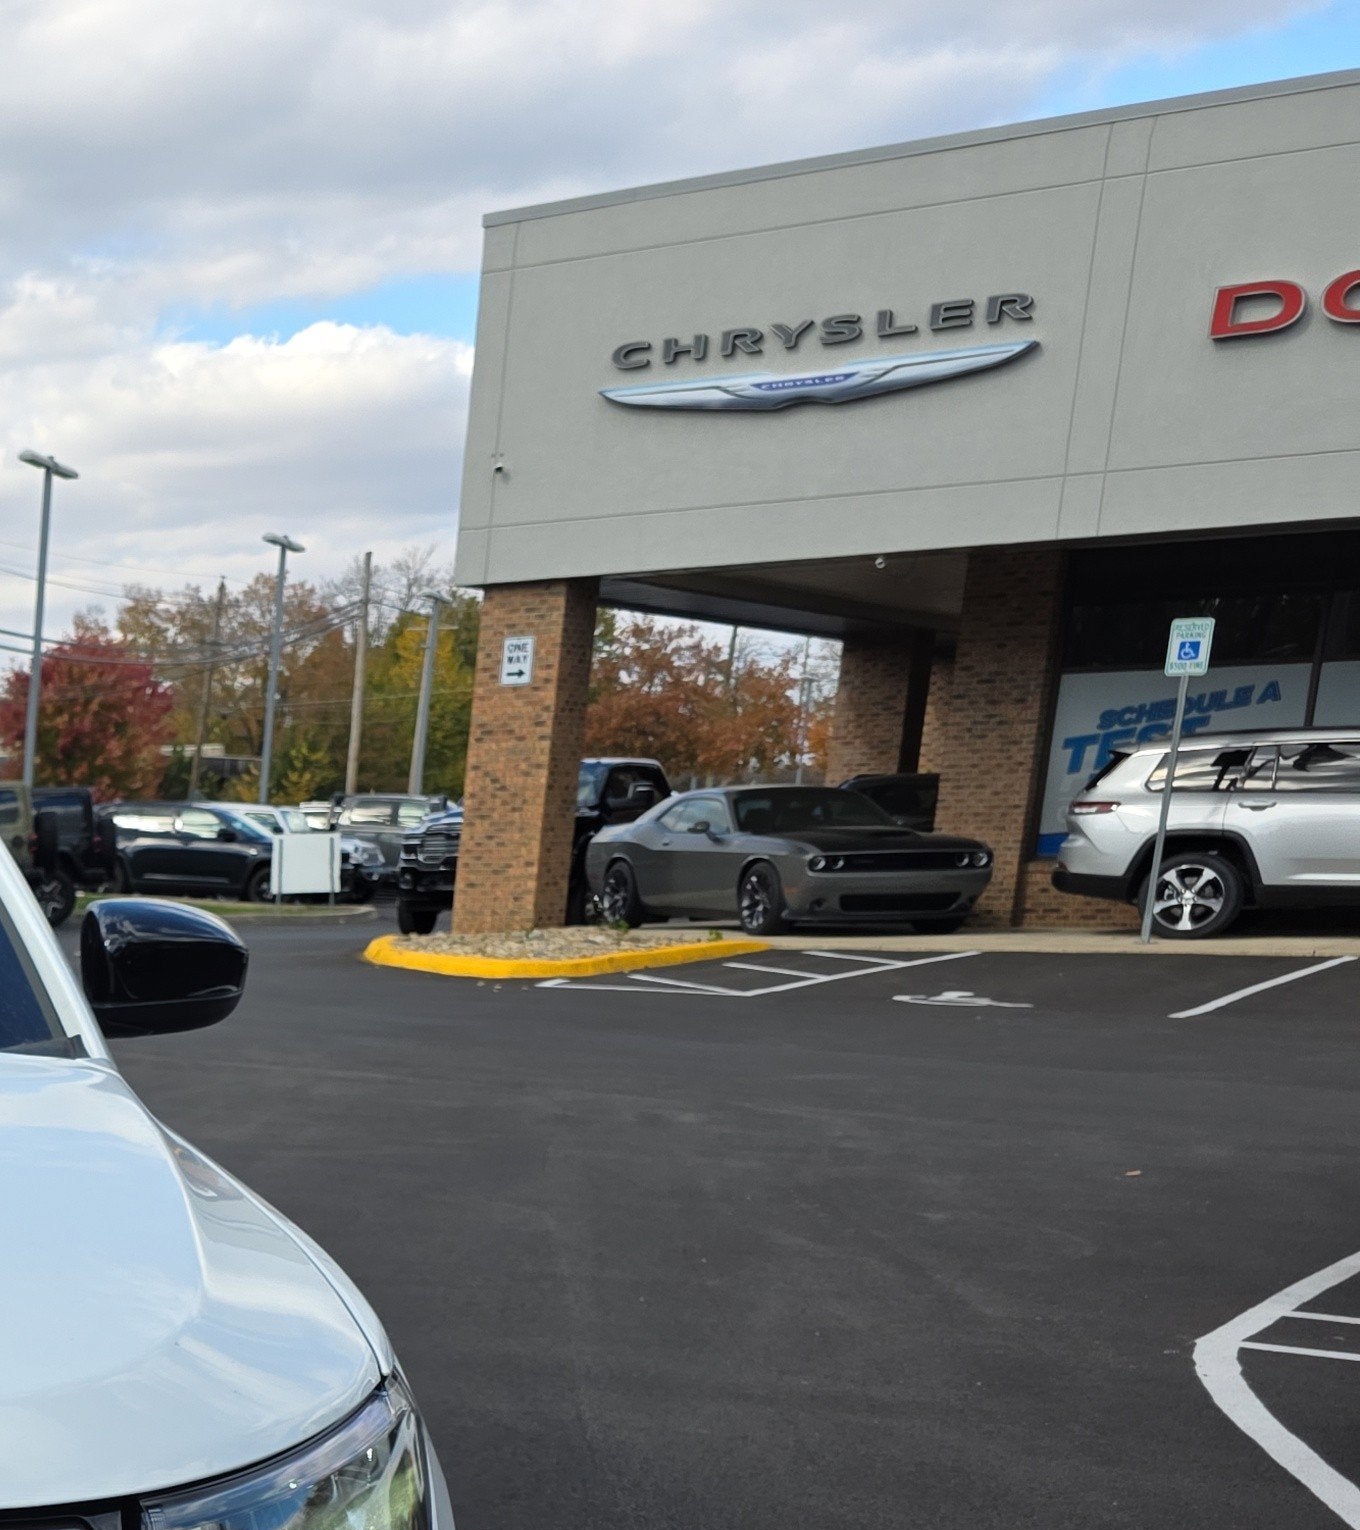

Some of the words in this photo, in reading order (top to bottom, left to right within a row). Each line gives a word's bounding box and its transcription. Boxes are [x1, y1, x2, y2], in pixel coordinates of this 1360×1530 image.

[611, 293, 1035, 371] CHRYSLER
[507, 642, 530, 654] ONE
[506, 655, 529, 665] WAY
[1256, 680, 1281, 705] A
